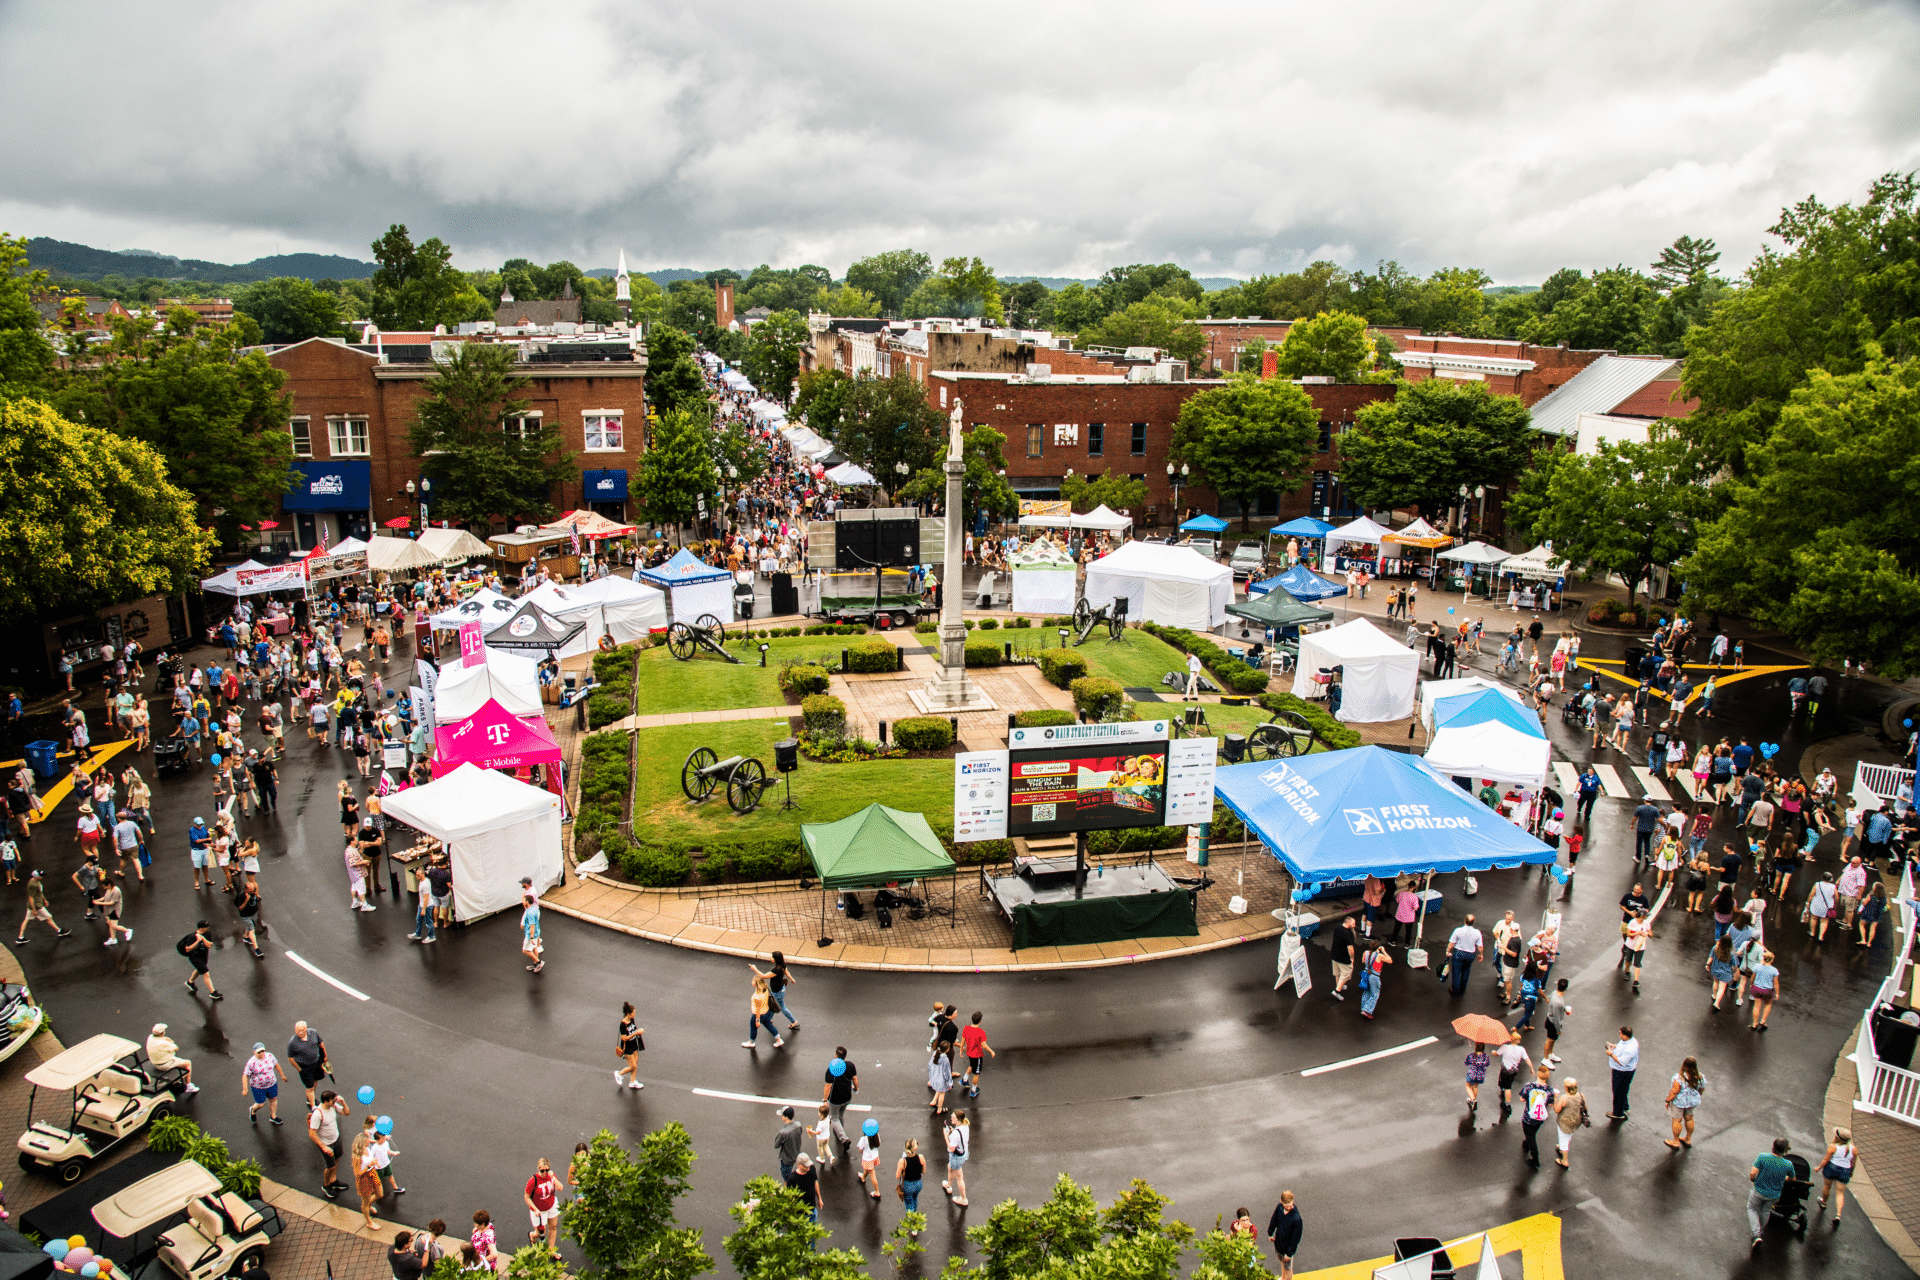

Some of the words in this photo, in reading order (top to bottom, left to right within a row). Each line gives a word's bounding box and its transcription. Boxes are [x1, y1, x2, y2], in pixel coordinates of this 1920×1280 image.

[1054, 424, 1078, 441] F&M
[418, 698, 426, 722] PARKS
[1055, 727, 1069, 740] MAIN
[1070, 725, 1092, 738] STREET
[1093, 724, 1120, 737] FESTIVAL
[493, 756, 522, 767] Mobile
[1287, 774, 1320, 800] FIRST
[1380, 804, 1431, 819] FIRST
